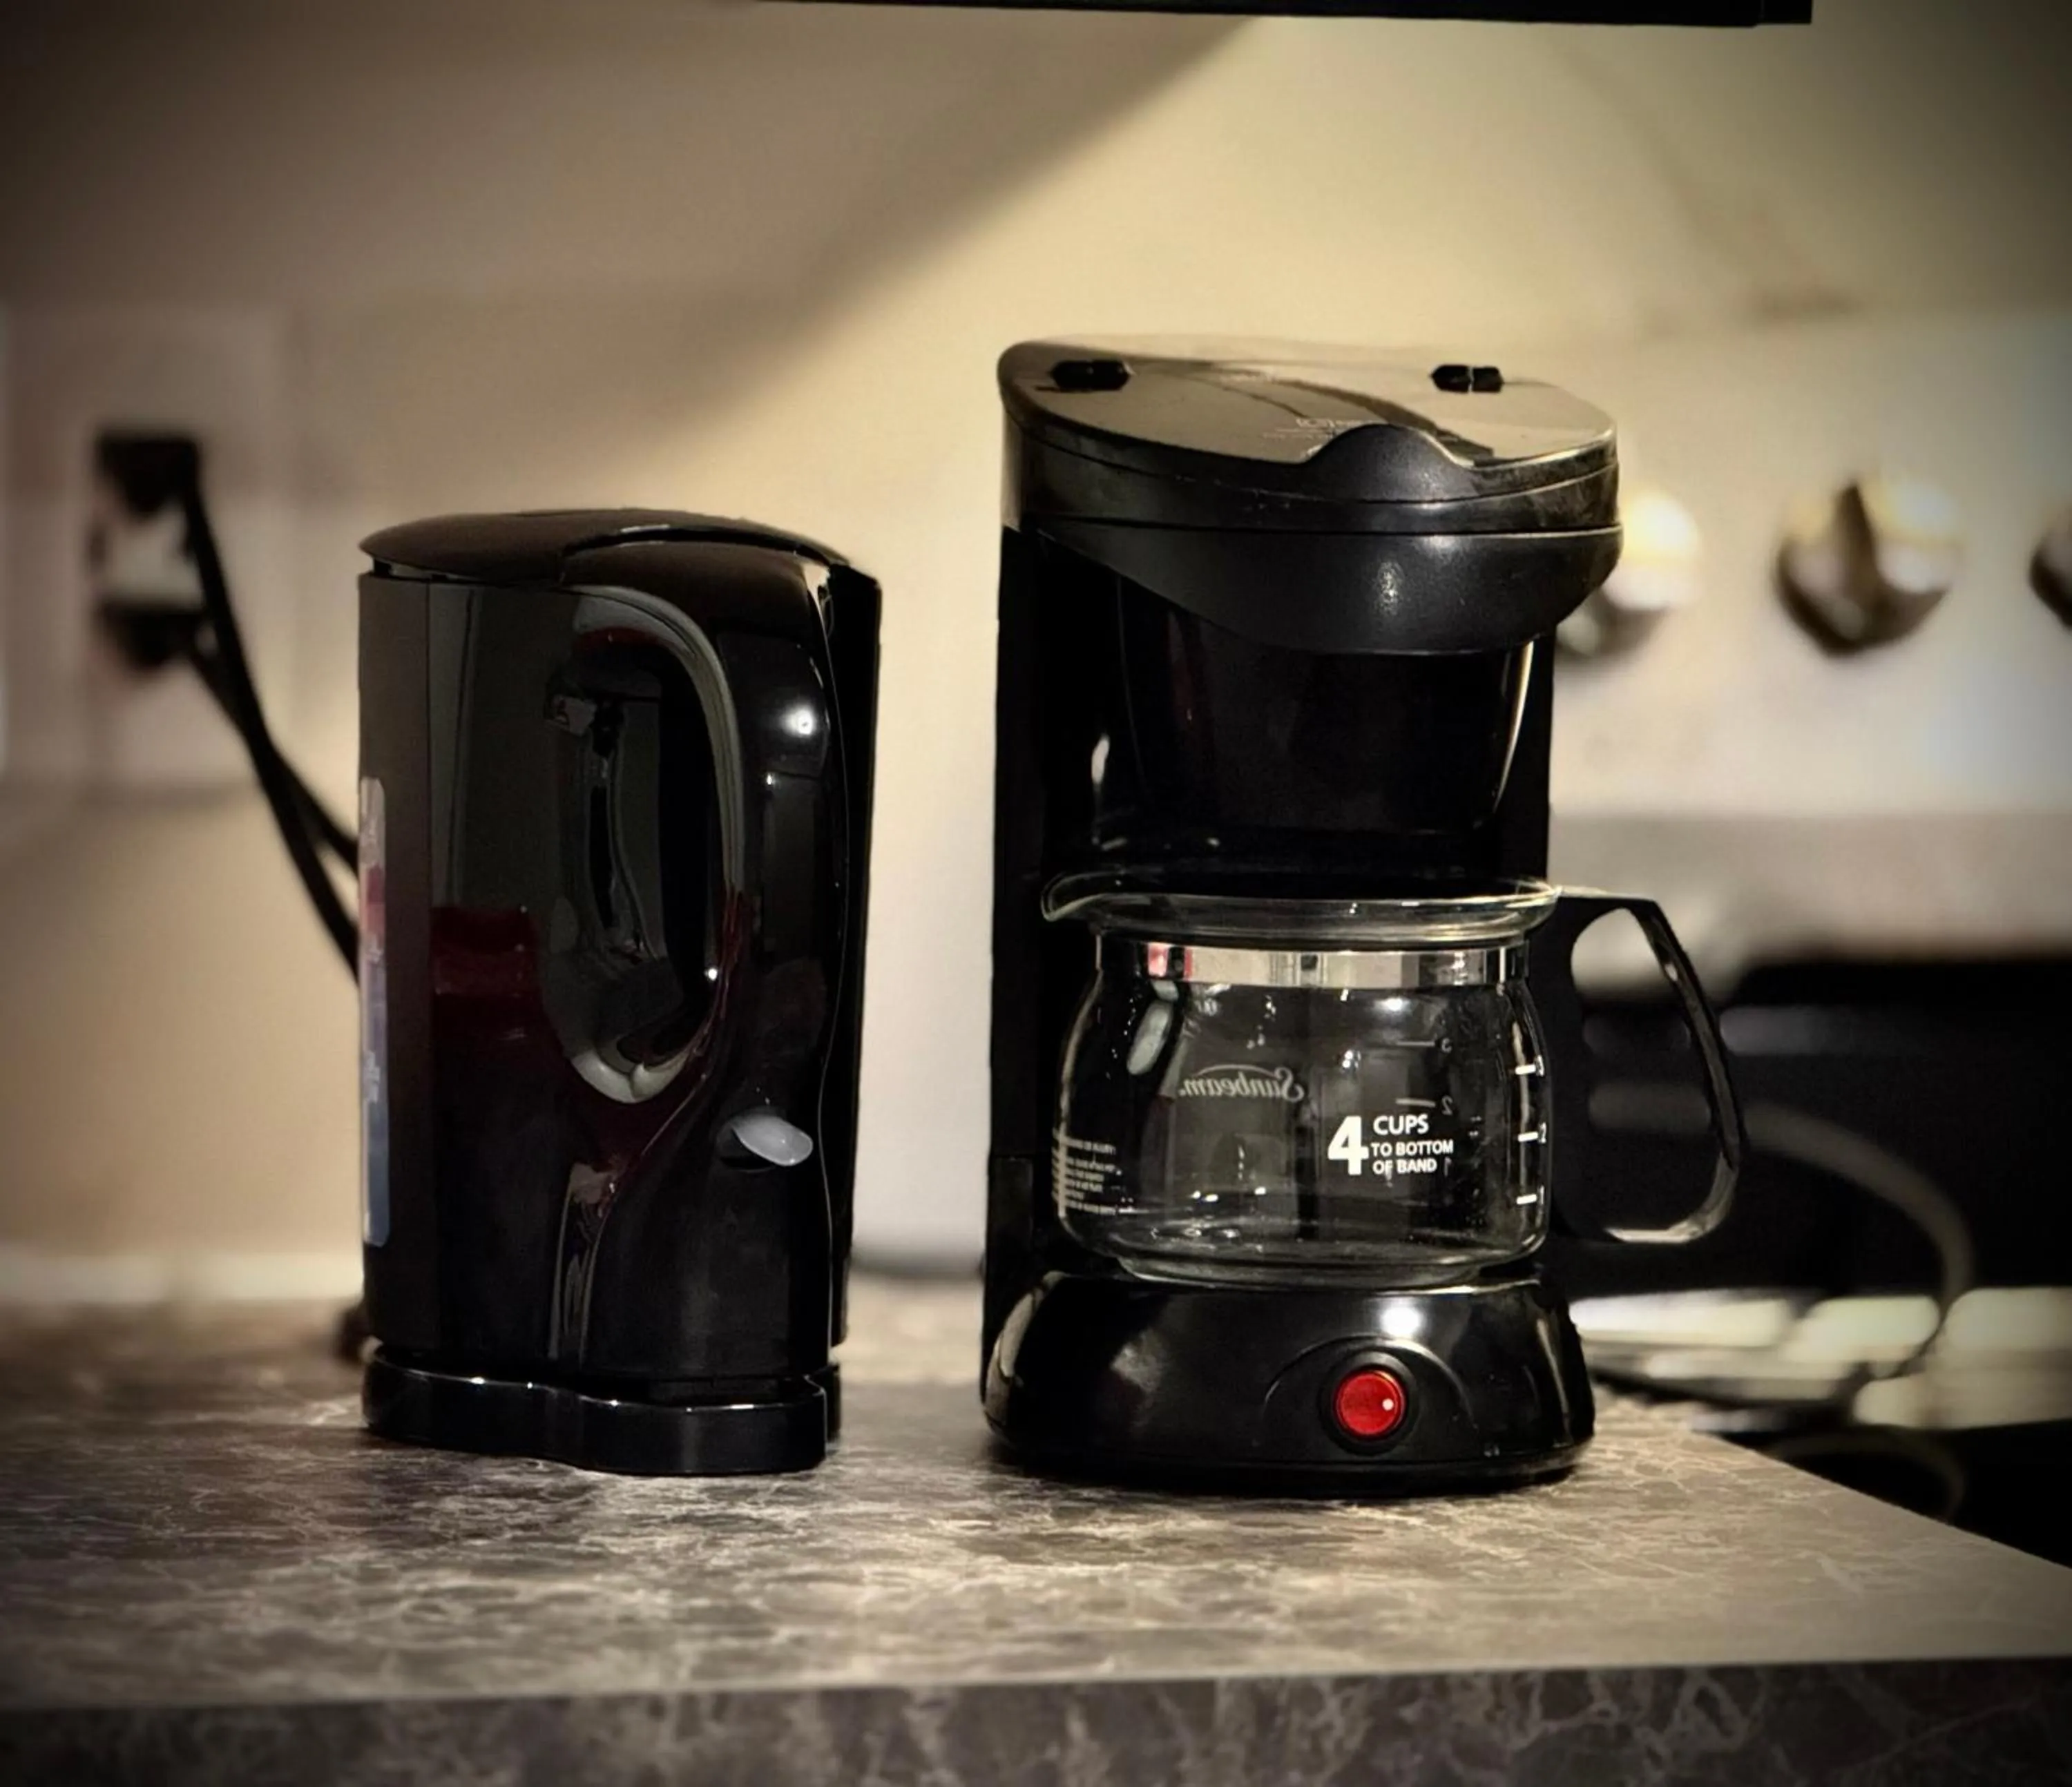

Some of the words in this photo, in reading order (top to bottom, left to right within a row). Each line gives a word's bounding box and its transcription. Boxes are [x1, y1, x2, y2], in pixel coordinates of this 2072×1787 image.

[1327, 1115, 1370, 1176] 4
[1372, 1114, 1429, 1136] CUPS
[1371, 1143, 1392, 1157] TO
[1396, 1140, 1454, 1156] BOTTOM
[1372, 1161, 1393, 1175] OF
[1397, 1159, 1437, 1174] BAND
